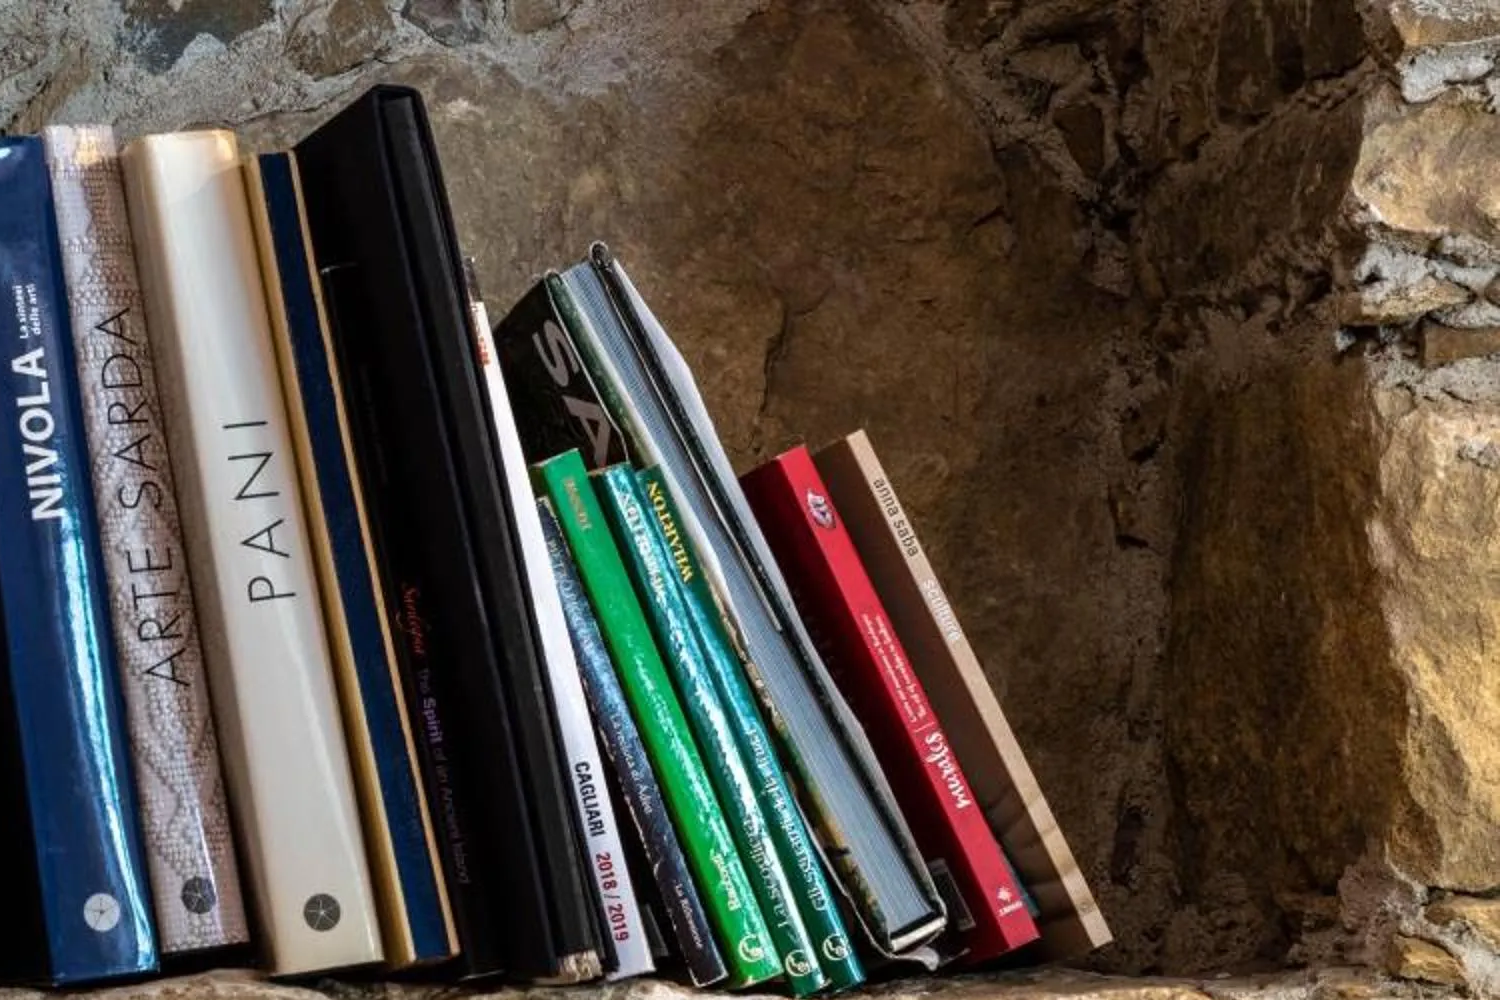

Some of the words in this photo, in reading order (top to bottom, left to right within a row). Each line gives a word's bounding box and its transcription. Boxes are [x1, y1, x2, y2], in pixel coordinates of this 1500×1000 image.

[19, 325, 29, 339] La
[26, 284, 37, 304] arti
[29, 307, 41, 336] delle
[12, 346, 70, 522] NIVOLA
[95, 307, 163, 510] SARDA
[223, 421, 297, 602] PANI
[647, 480, 693, 583] WHARTON
[873, 478, 899, 517] anna
[893, 519, 919, 557] saba
[129, 546, 191, 687] ARTE
[422, 696, 444, 744] Spirit
[925, 731, 971, 809] murales
[574, 761, 606, 837] CAGLIARI
[596, 851, 618, 891] 2018
[608, 903, 630, 942] 2019
